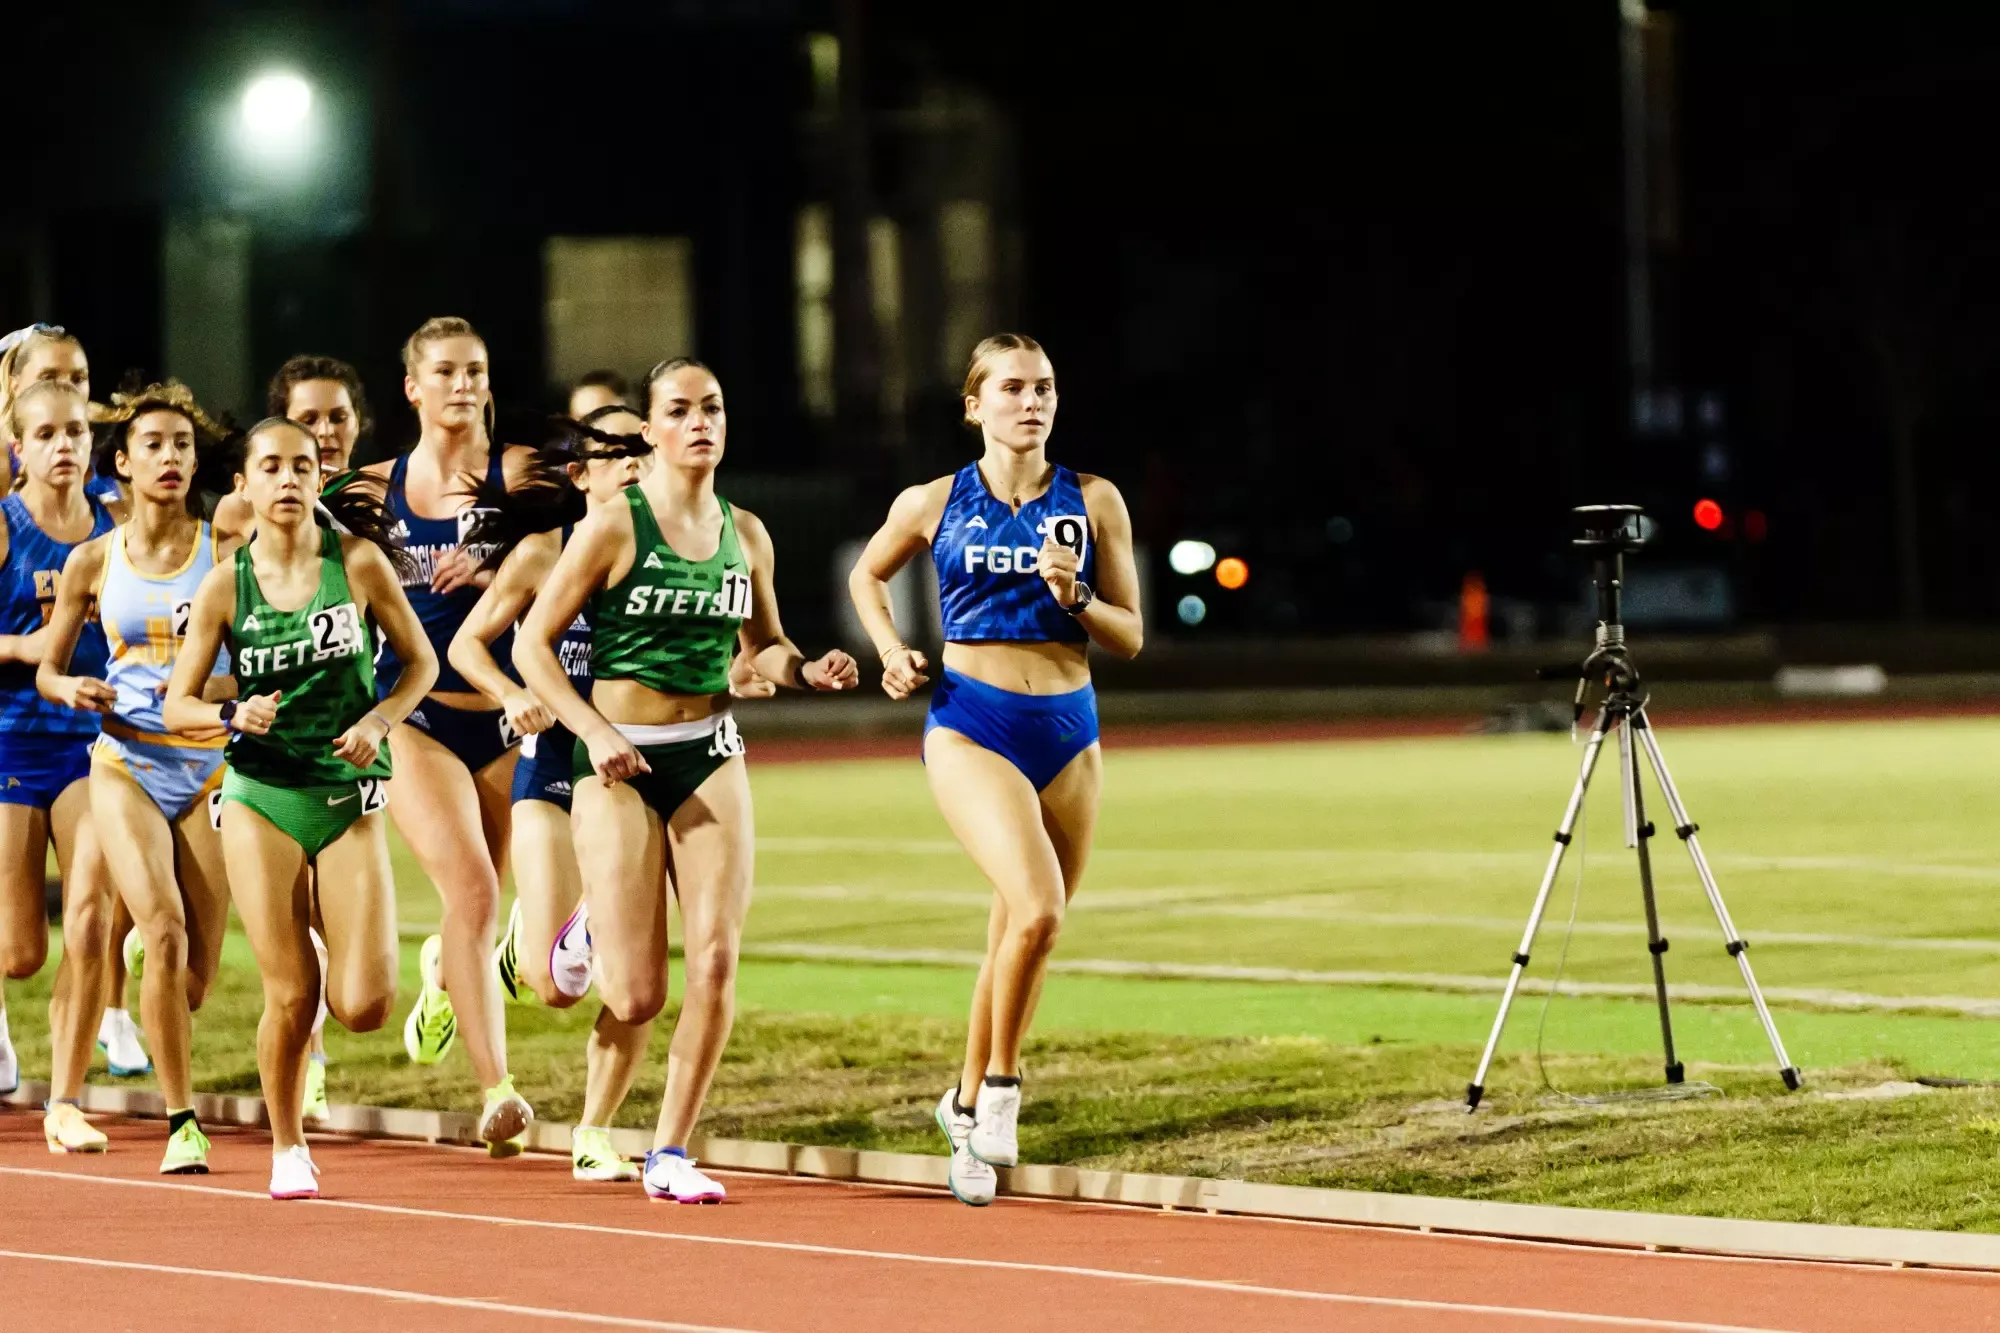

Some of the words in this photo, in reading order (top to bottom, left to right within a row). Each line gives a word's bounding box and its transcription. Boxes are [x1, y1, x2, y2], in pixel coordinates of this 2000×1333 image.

[965, 546, 1038, 574] FGC
[725, 574, 748, 614] 17
[176, 602, 191, 636] 2
[313, 607, 356, 651] 23
[358, 780, 385, 812] 2
